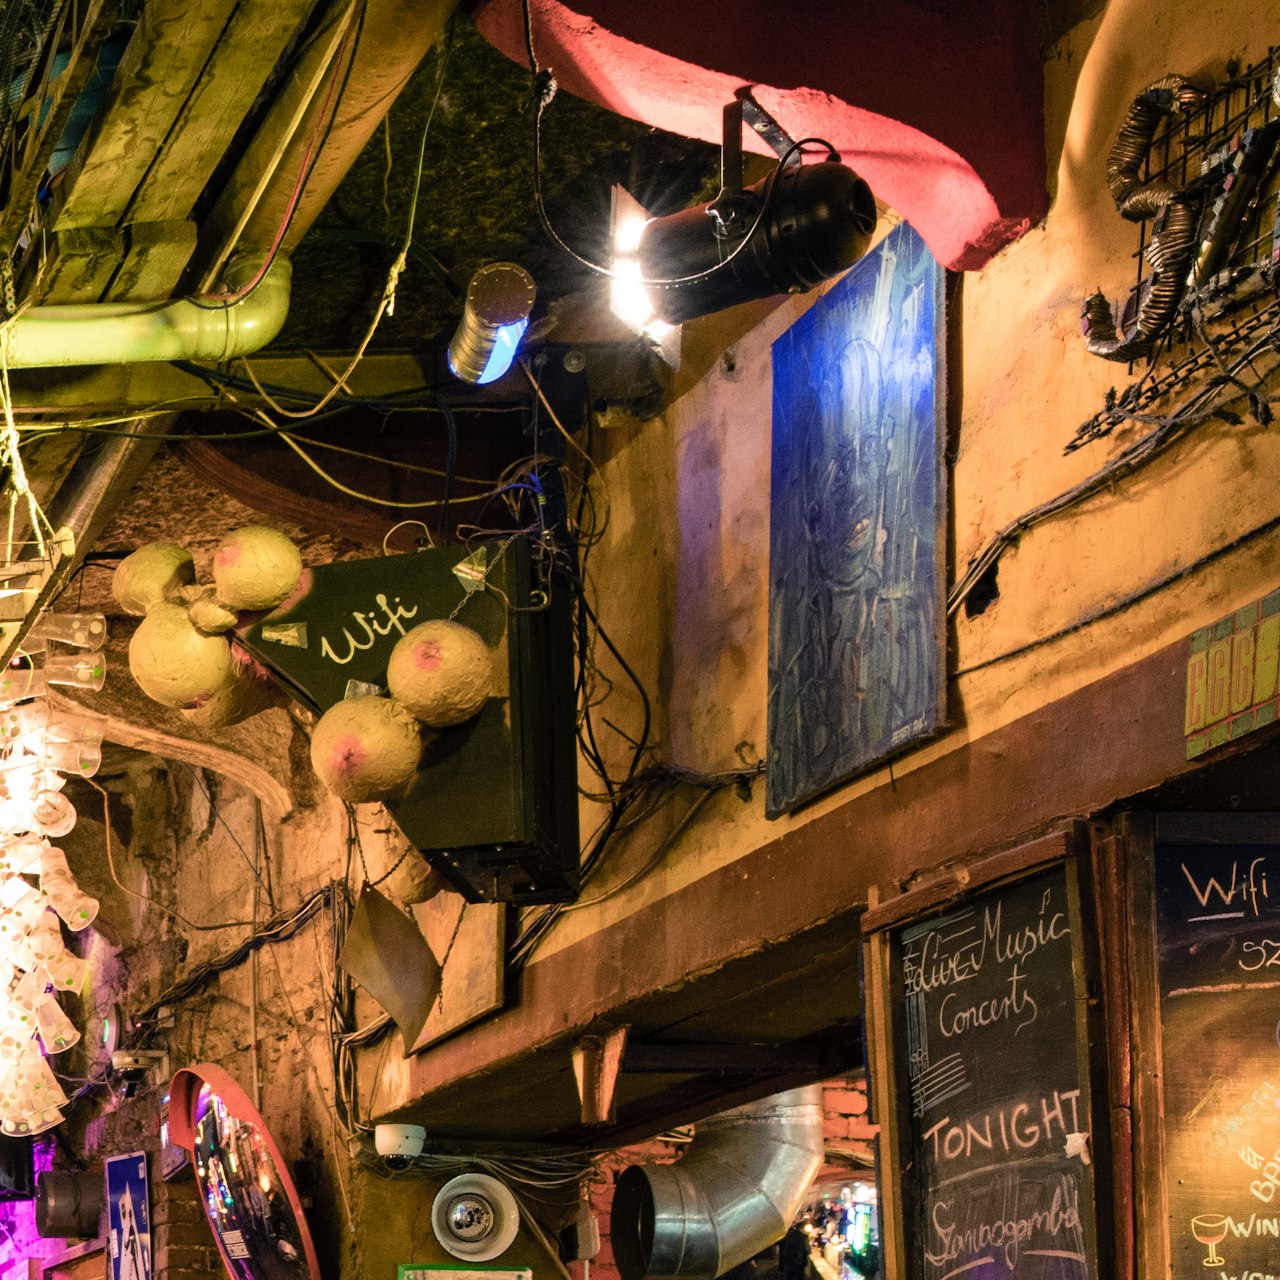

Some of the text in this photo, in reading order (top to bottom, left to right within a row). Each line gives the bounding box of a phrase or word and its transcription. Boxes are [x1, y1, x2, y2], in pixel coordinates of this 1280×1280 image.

[322, 594, 418, 664] Wifi
[1181, 857, 1268, 916] Wifi
[970, 900, 1072, 970] Music
[939, 963, 1038, 1037] Concerts
[923, 1088, 1081, 1162] TONIGHT
